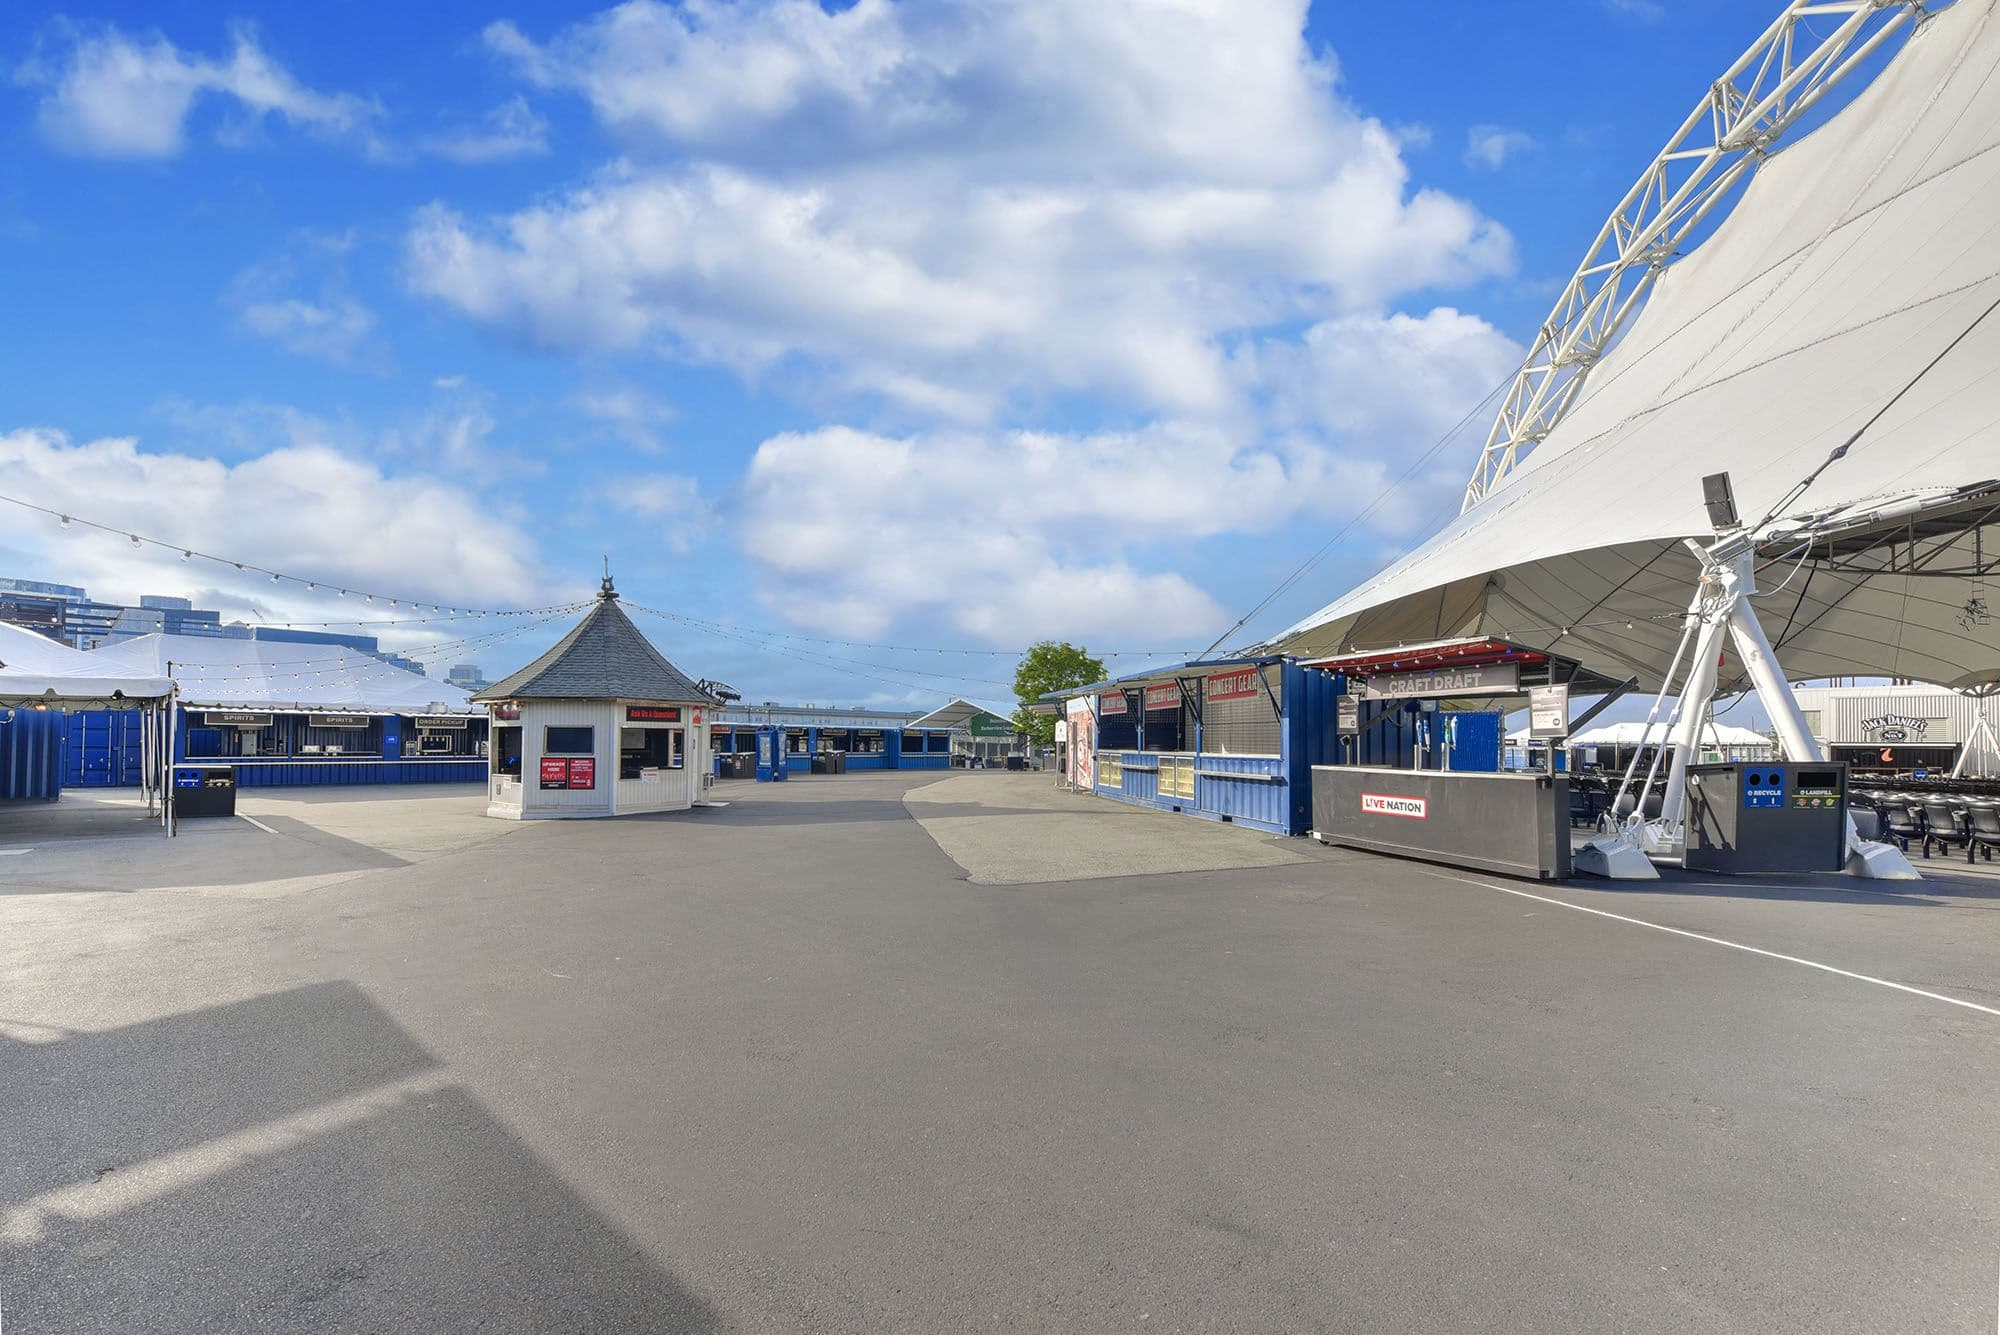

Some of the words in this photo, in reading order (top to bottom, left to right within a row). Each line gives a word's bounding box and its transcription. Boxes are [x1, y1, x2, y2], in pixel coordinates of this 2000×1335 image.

[1209, 676, 1237, 696] CONCERT
[1238, 673, 1257, 692] GEAR
[1389, 677, 1431, 693] CRAFT
[1434, 673, 1482, 690] DRAFT
[1147, 688, 1167, 704] CONCERT
[1862, 718, 1887, 731] JACK
[1365, 798, 1385, 809] LIVE
[1386, 800, 1422, 813] NATION
